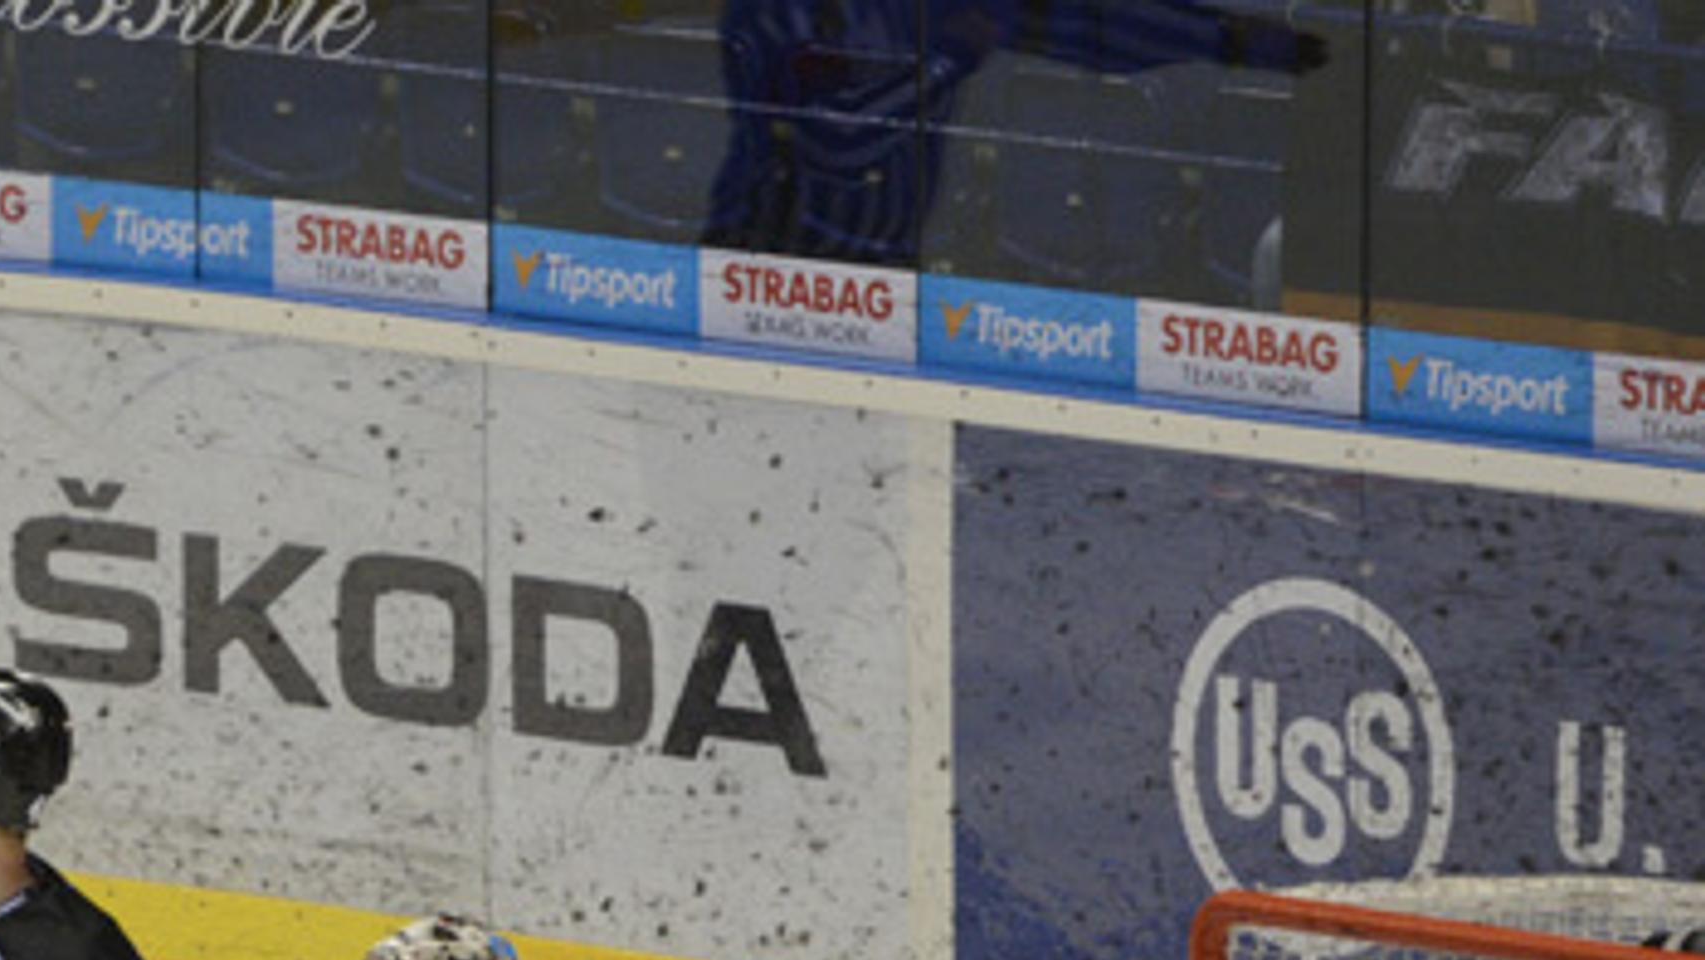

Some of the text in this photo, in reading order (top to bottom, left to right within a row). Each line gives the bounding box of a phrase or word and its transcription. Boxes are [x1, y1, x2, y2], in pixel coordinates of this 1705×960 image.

[112, 207, 250, 258] Tipsport
[295, 214, 466, 271] STRABAG
[544, 252, 677, 310] Tipsport
[722, 263, 894, 322] STRABAG
[976, 304, 1113, 361] Tipsport
[1162, 313, 1339, 374] STRABAG
[1425, 357, 1571, 417] Tipsport
[13, 477, 828, 778] ŠKODA
[1216, 674, 1412, 865] USS
[1555, 720, 1667, 874] U.
